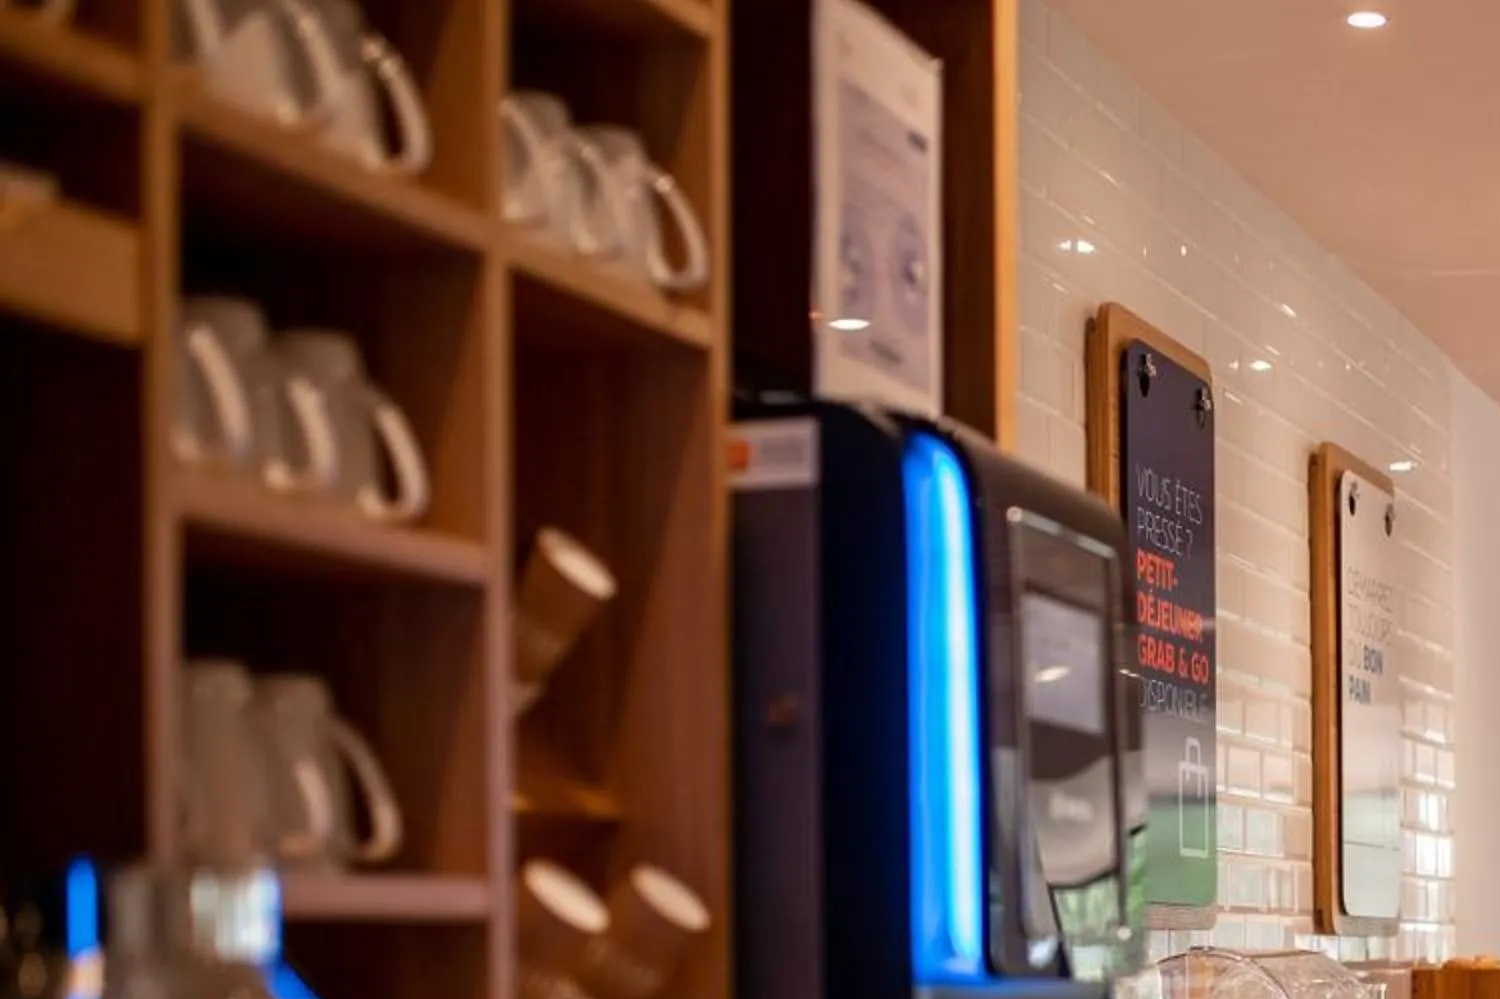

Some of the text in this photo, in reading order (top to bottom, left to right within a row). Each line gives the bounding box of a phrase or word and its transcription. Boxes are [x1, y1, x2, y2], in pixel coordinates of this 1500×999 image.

[1136, 463, 1171, 510] VOUS
[1137, 547, 1178, 592] PETIT-
[1138, 589, 1203, 644] DÉJEUNER
[1138, 633, 1209, 685] GRAB & GO
[1363, 643, 1383, 676] BON
[1349, 674, 1371, 704] PAIN
